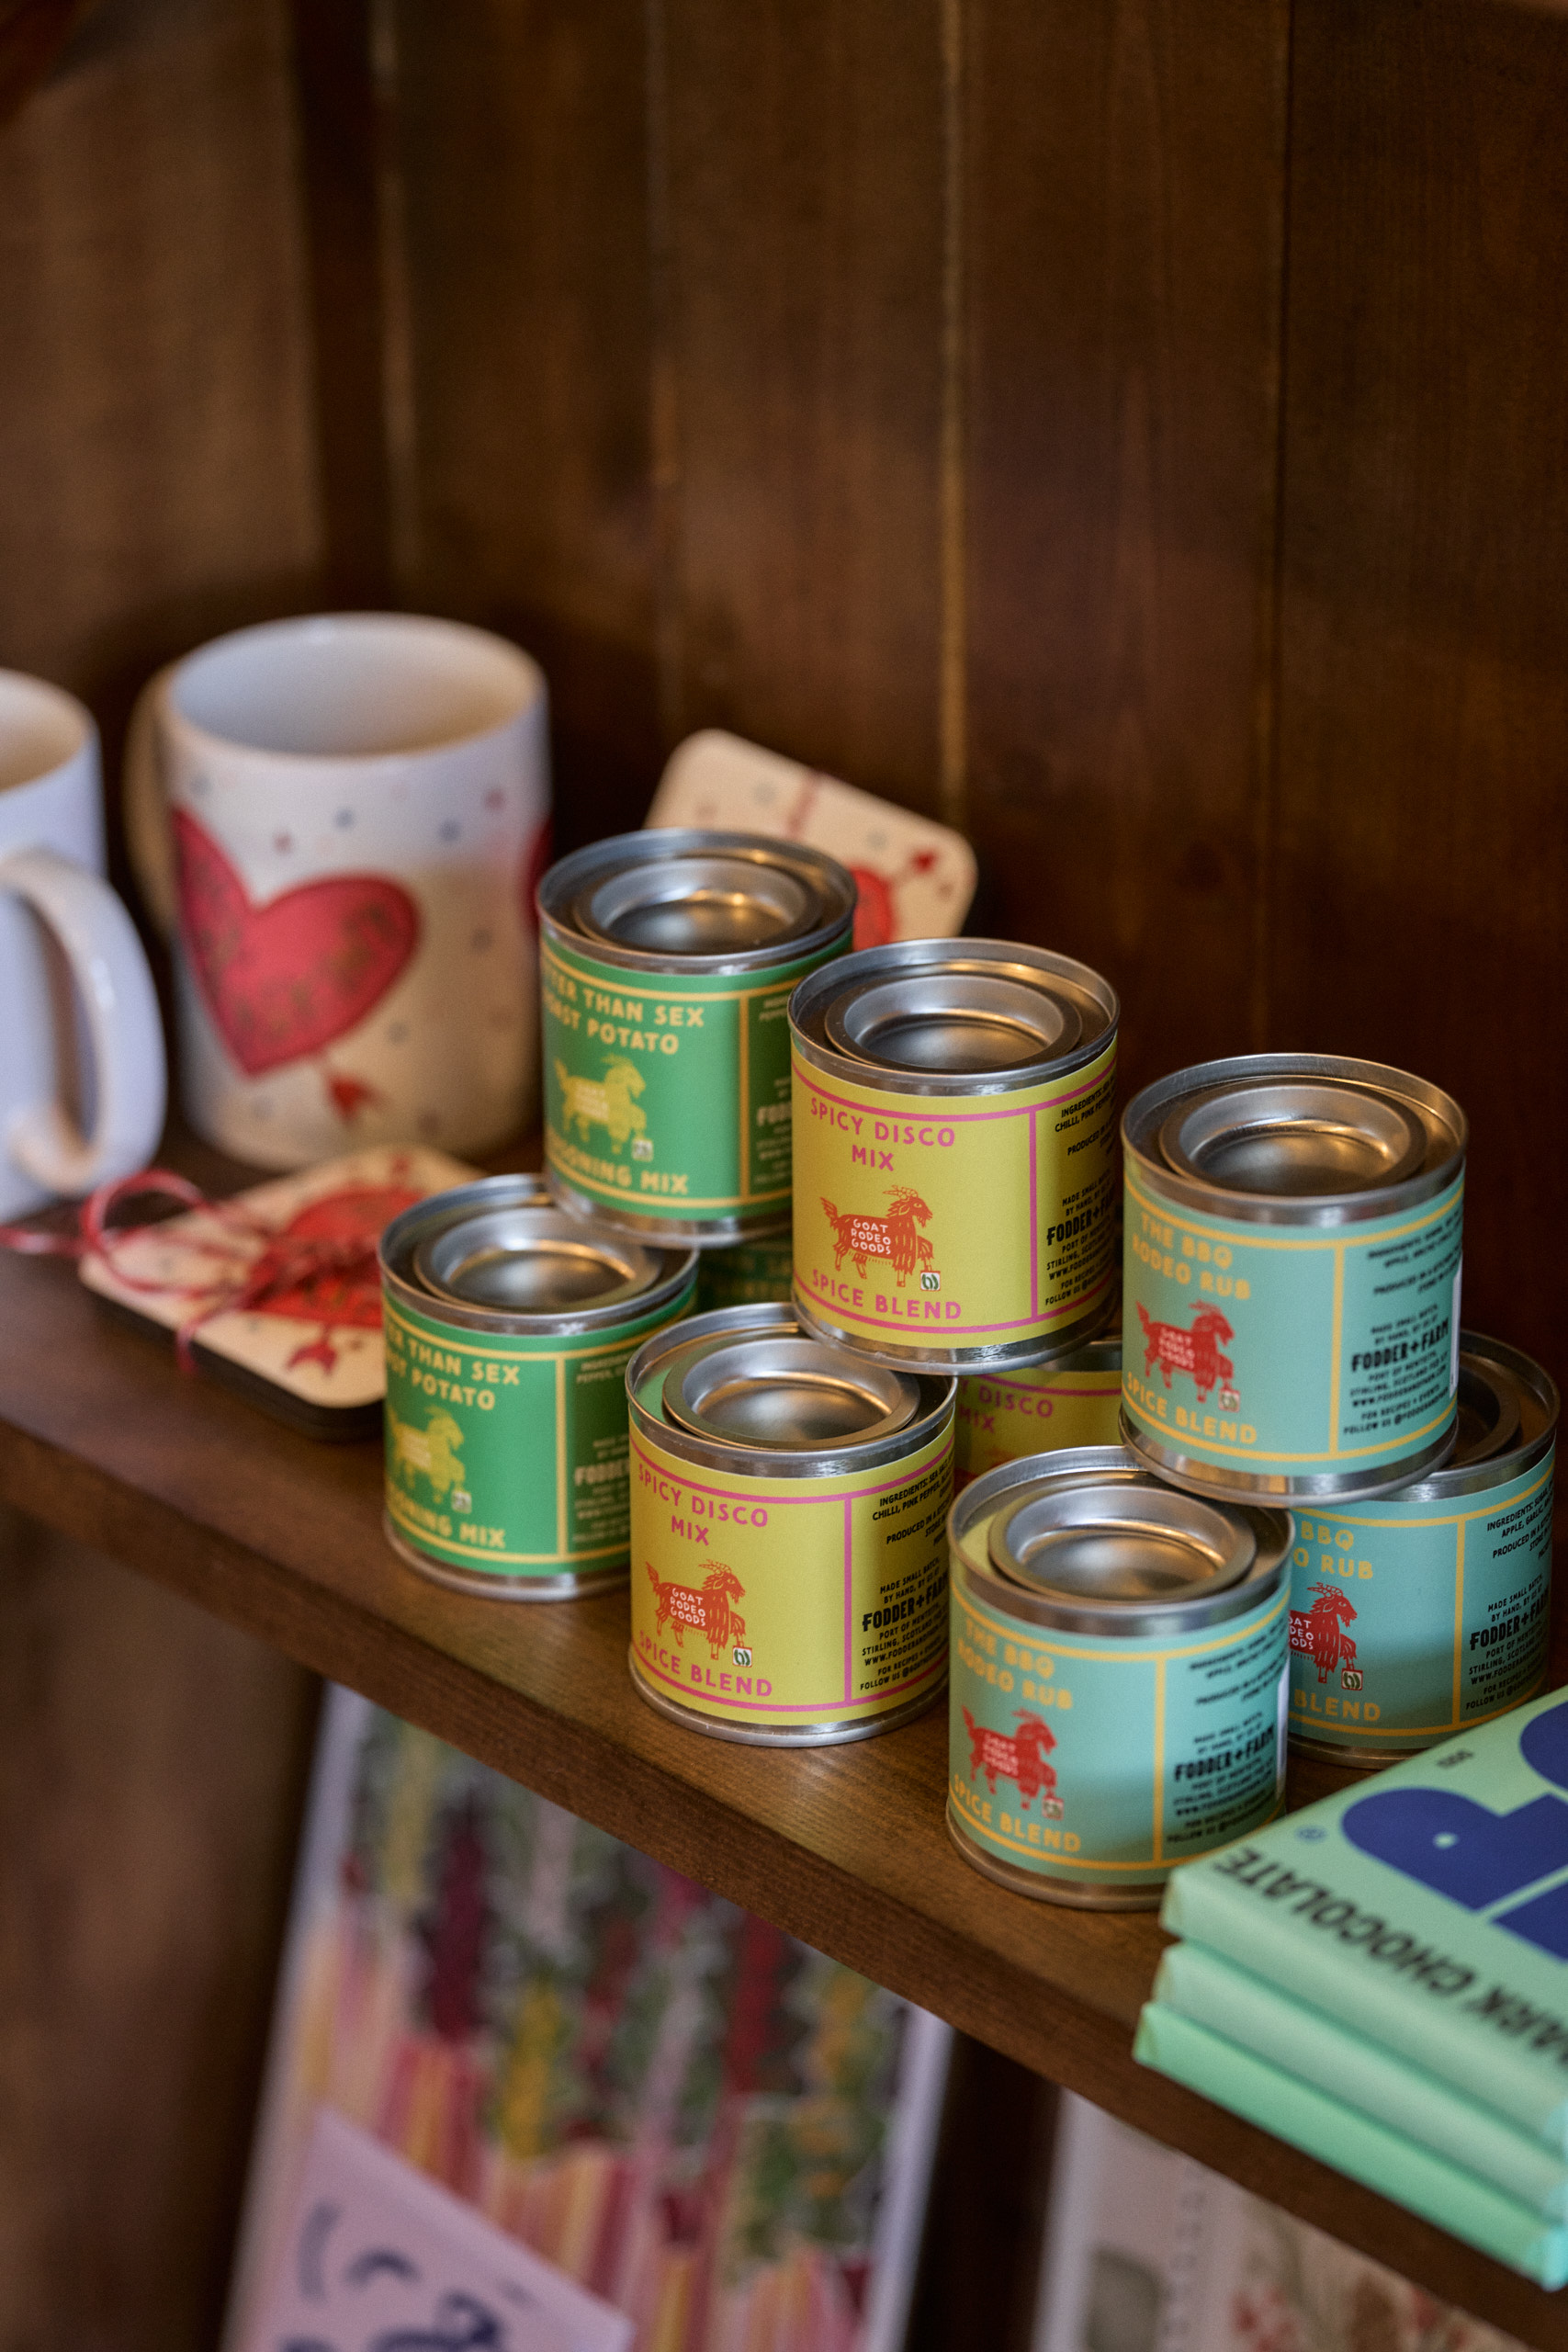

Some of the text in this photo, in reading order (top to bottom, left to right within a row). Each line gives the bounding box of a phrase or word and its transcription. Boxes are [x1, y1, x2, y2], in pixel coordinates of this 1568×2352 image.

[582, 988, 643, 1023] THAN
[654, 1005, 705, 1027] SEX
[587, 1018, 680, 1056] POTATO
[810, 1097, 955, 1148] SPICY DISCO
[852, 1145, 894, 1171] MIX
[640, 1170, 689, 1195] MIX
[1062, 1192, 1079, 1206] MADE
[851, 1227, 891, 1245] RODEO
[853, 1218, 888, 1234] GOAT
[851, 1238, 891, 1255] GOODS
[1141, 1211, 1174, 1249] THE
[1182, 1236, 1233, 1271] BBQ
[1132, 1233, 1191, 1285] RODEO
[1200, 1271, 1251, 1301] RUB
[812, 1269, 864, 1307] SPICE
[875, 1295, 962, 1320] BLEND
[1045, 1288, 1071, 1306] FOLLOW
[408, 1338, 462, 1376] THAN
[471, 1361, 521, 1386] SEX
[411, 1366, 496, 1411] POTATO
[978, 1385, 1054, 1419] DISCO
[1127, 1371, 1258, 1445] SPICE BLEND
[958, 1403, 995, 1434] MIX
[637, 1463, 769, 1528] SPICY DISCO
[459, 1522, 505, 1549] MIX
[671, 1515, 709, 1547] MIX
[886, 1520, 925, 1544] PRODUCED
[1301, 1521, 1355, 1552] BBQ
[1493, 1534, 1529, 1558] PRODUCED
[1320, 1554, 1374, 1579] RUB
[880, 1580, 900, 1594] MADE
[902, 1569, 921, 1586] SMALL
[670, 1596, 706, 1617] RODEO
[671, 1588, 704, 1606] GOAT
[884, 1593, 893, 1604] BY
[1488, 1598, 1506, 1612] MADE
[1509, 1588, 1527, 1604] SMALL
[670, 1606, 706, 1627] GOODS
[1288, 1616, 1312, 1629] OAT
[1491, 1611, 1500, 1623] BY
[879, 1627, 898, 1640] PORT
[900, 1622, 909, 1633] OF
[965, 1617, 998, 1657] THE
[1290, 1625, 1314, 1641] DEO
[1290, 1637, 1314, 1650] ODS
[862, 1638, 899, 1656] STIRLING,
[1485, 1645, 1505, 1659] PORT
[1506, 1639, 1515, 1650] OF
[639, 1629, 773, 1698] SPICE BLEND
[878, 1665, 891, 1676] FOR
[1469, 1657, 1506, 1675] STIRLING,
[860, 1676, 889, 1690] FOLLOW
[892, 1672, 900, 1681] US
[1483, 1683, 1496, 1694] FOR
[1021, 1679, 1074, 1710] RUB
[1294, 1689, 1382, 1722] BLEND
[1466, 1694, 1495, 1710] FOLLOW
[953, 1773, 1082, 1853] SPICE BLEND
[1213, 1848, 1568, 2069] ARK CHOCOLATE
